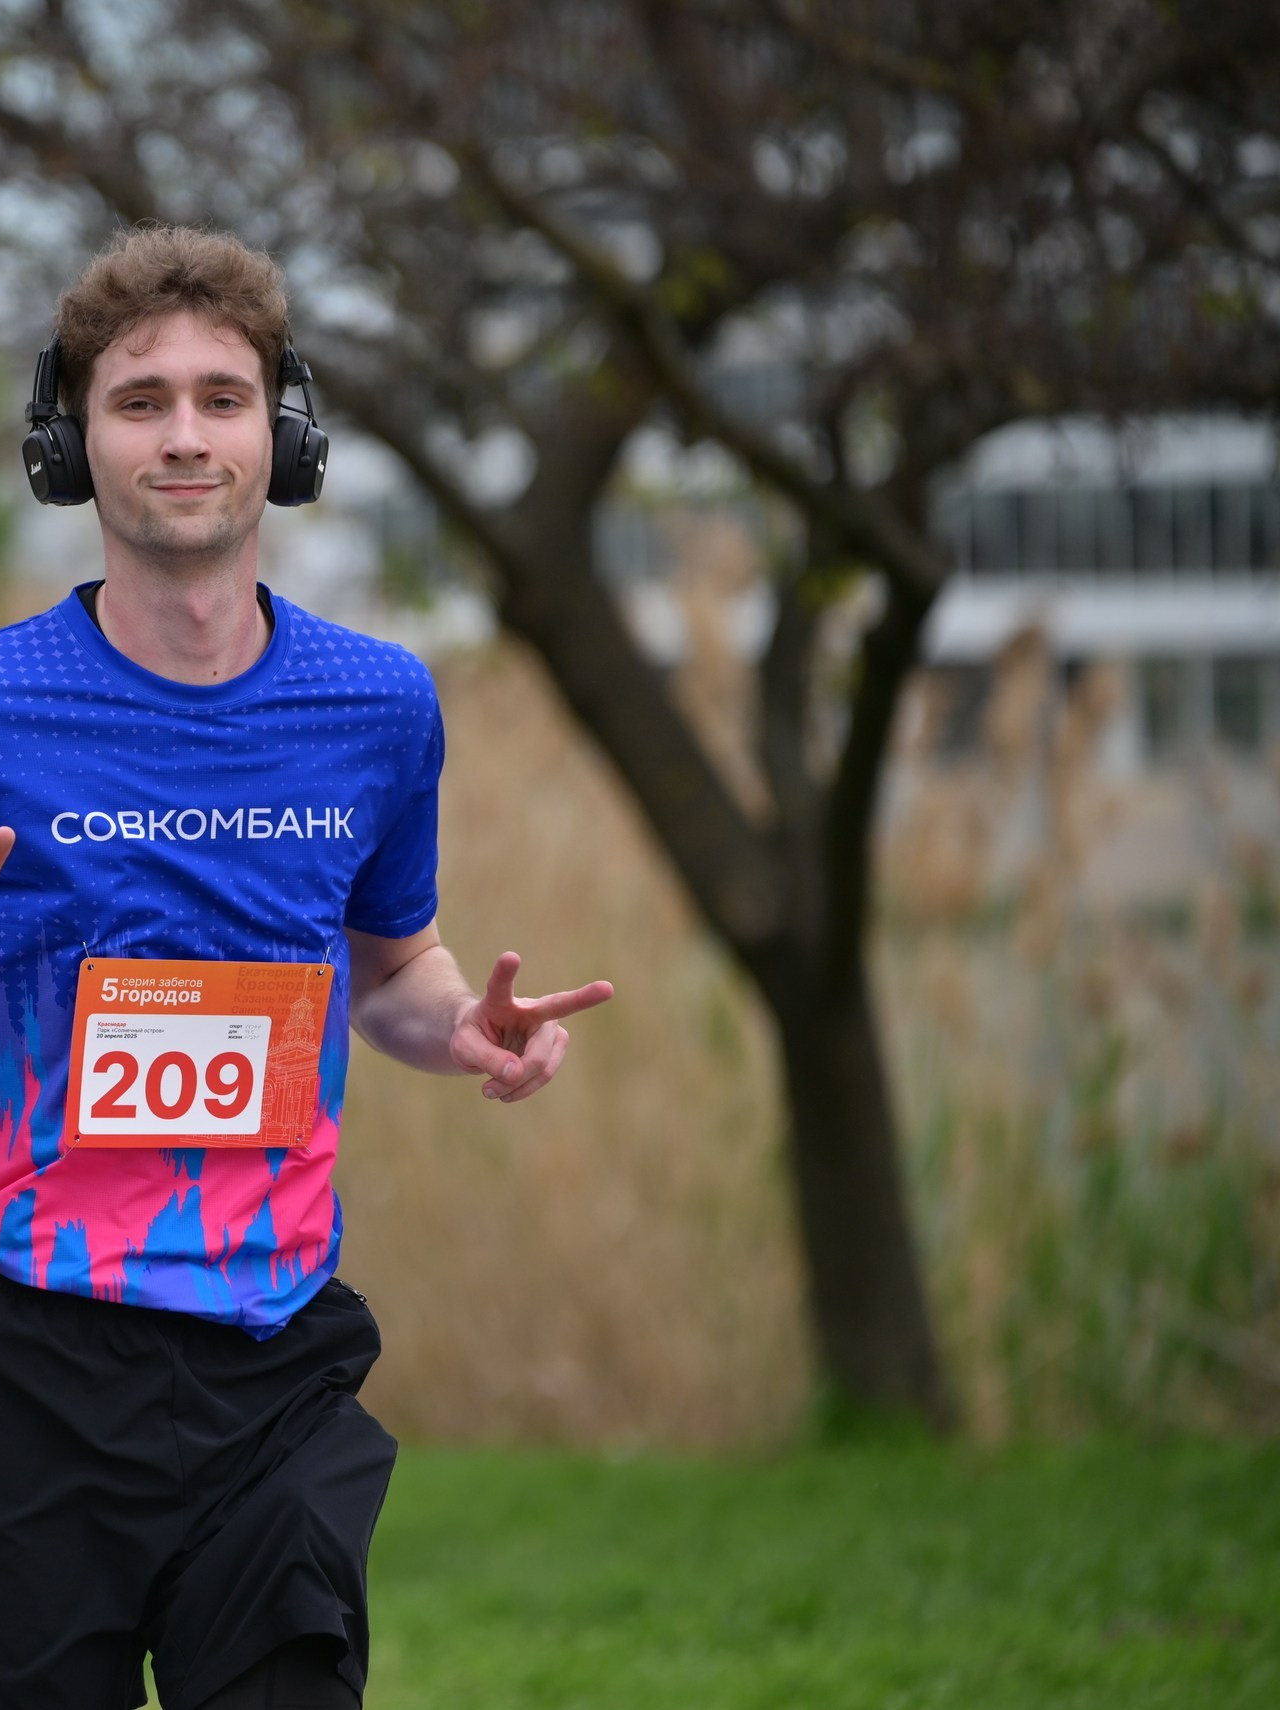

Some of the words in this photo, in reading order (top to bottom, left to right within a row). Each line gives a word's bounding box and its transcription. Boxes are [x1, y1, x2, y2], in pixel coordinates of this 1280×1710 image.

[50, 807, 355, 845] СОВКОМБАНК
[100, 977, 119, 1002] 5
[119, 989, 201, 1006] городов
[121, 977, 156, 989] серия
[158, 976, 203, 988] забегов
[235, 977, 325, 994] Краснодар
[233, 992, 275, 1004] Казань
[90, 1050, 254, 1120] 209
